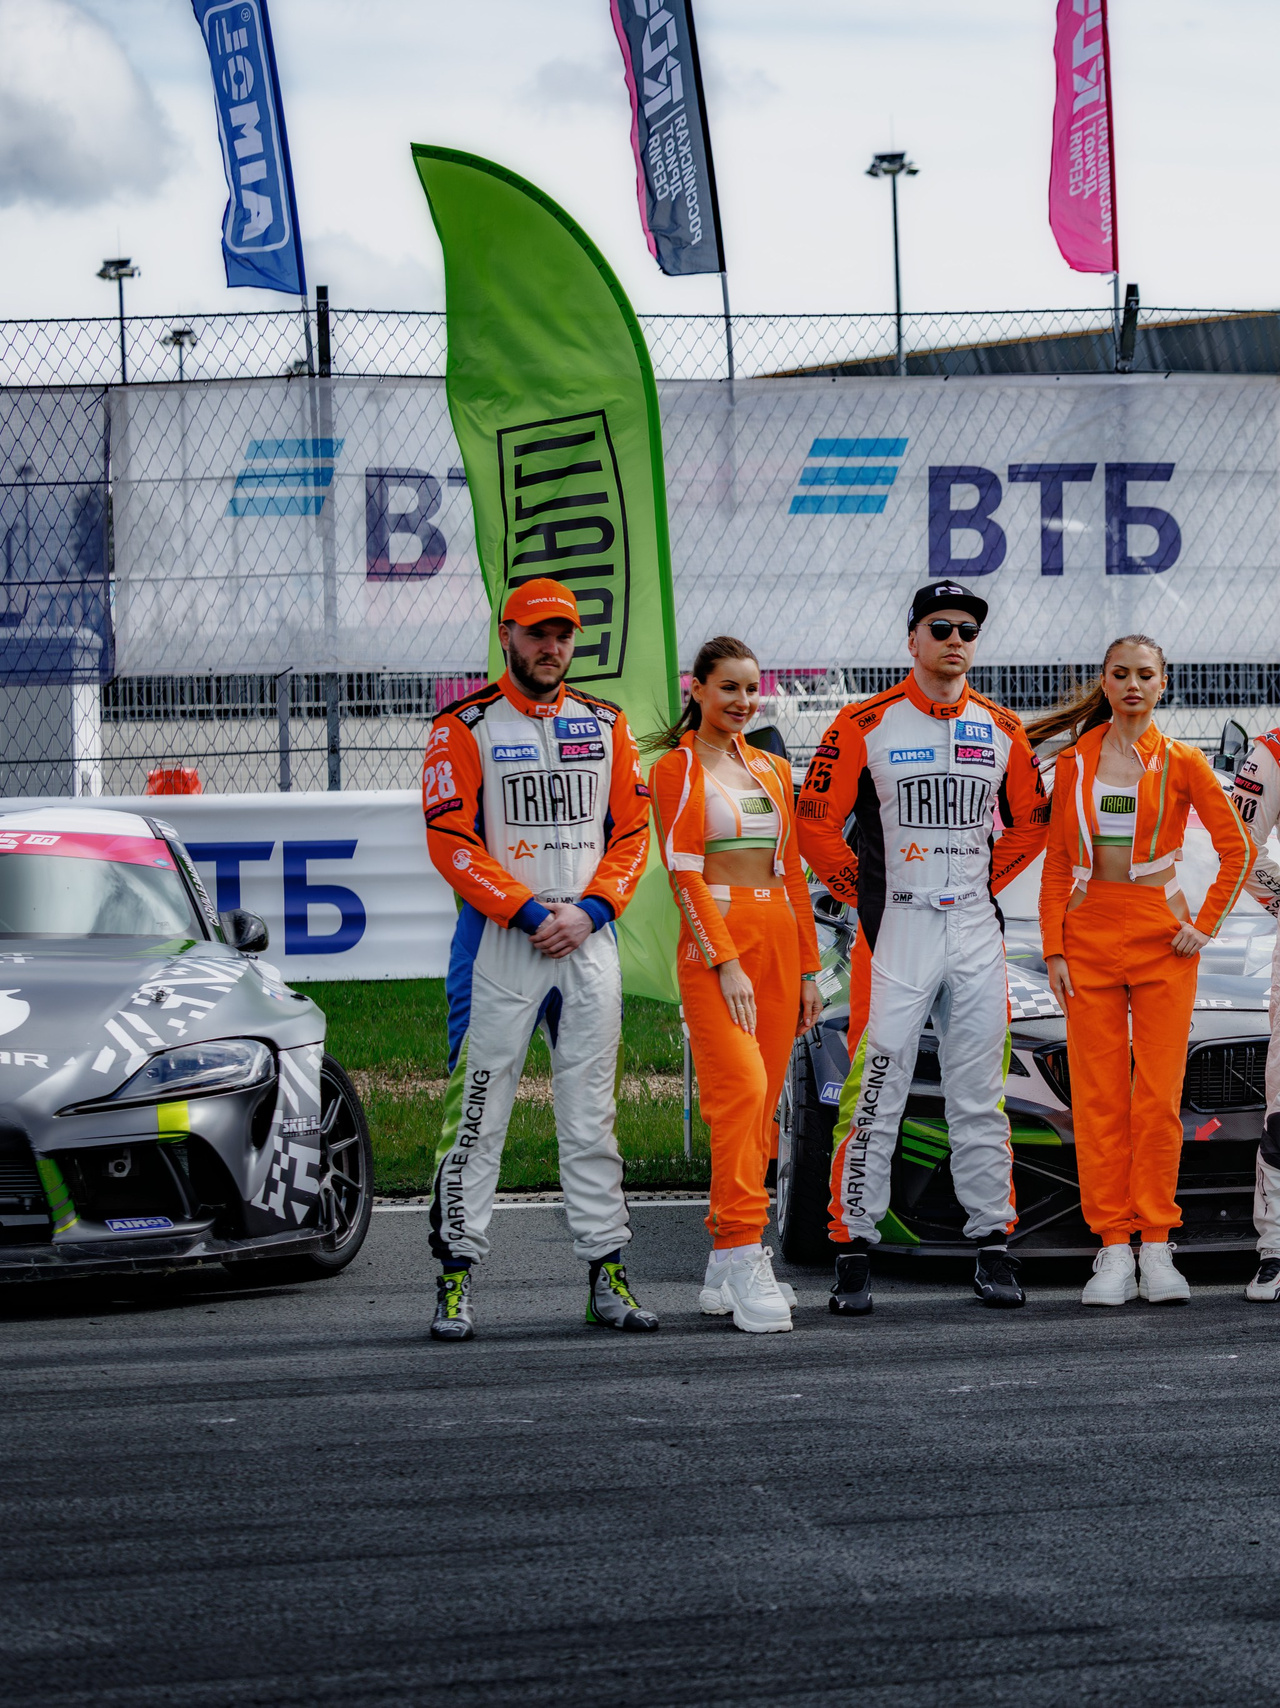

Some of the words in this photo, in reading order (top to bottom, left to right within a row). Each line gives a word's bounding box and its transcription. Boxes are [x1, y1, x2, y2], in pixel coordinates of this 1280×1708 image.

[928, 462, 1182, 577] ВТБ
[535, 705, 558, 716] CR
[941, 706, 958, 716] CR
[858, 713, 877, 728] OMP
[997, 717, 1016, 732] OMP
[569, 722, 597, 735] ВТБ
[965, 724, 989, 739] ВТБ
[496, 747, 537, 758] AIMOL
[562, 743, 589, 755] RDS
[891, 749, 932, 762] AIMOL
[957, 747, 982, 758] RDS
[424, 760, 456, 807] 28
[507, 773, 593, 821] TRIALLI
[902, 777, 986, 826] TRIALLI
[1102, 796, 1135, 813] TRIALLI
[741, 798, 773, 815] TRIALLI
[544, 841, 596, 851] AIRLINE
[934, 847, 980, 855] AIRLINE
[468, 867, 507, 900] LUZAR
[185, 839, 367, 956] ТБ
[754, 889, 770, 898] CR
[681, 887, 699, 919] RACING
[693, 918, 717, 959] CARVILLE
[460, 1069, 490, 1149] RACING
[849, 1130, 871, 1218] CARVILLE
[862, 1055, 891, 1126] RACING
